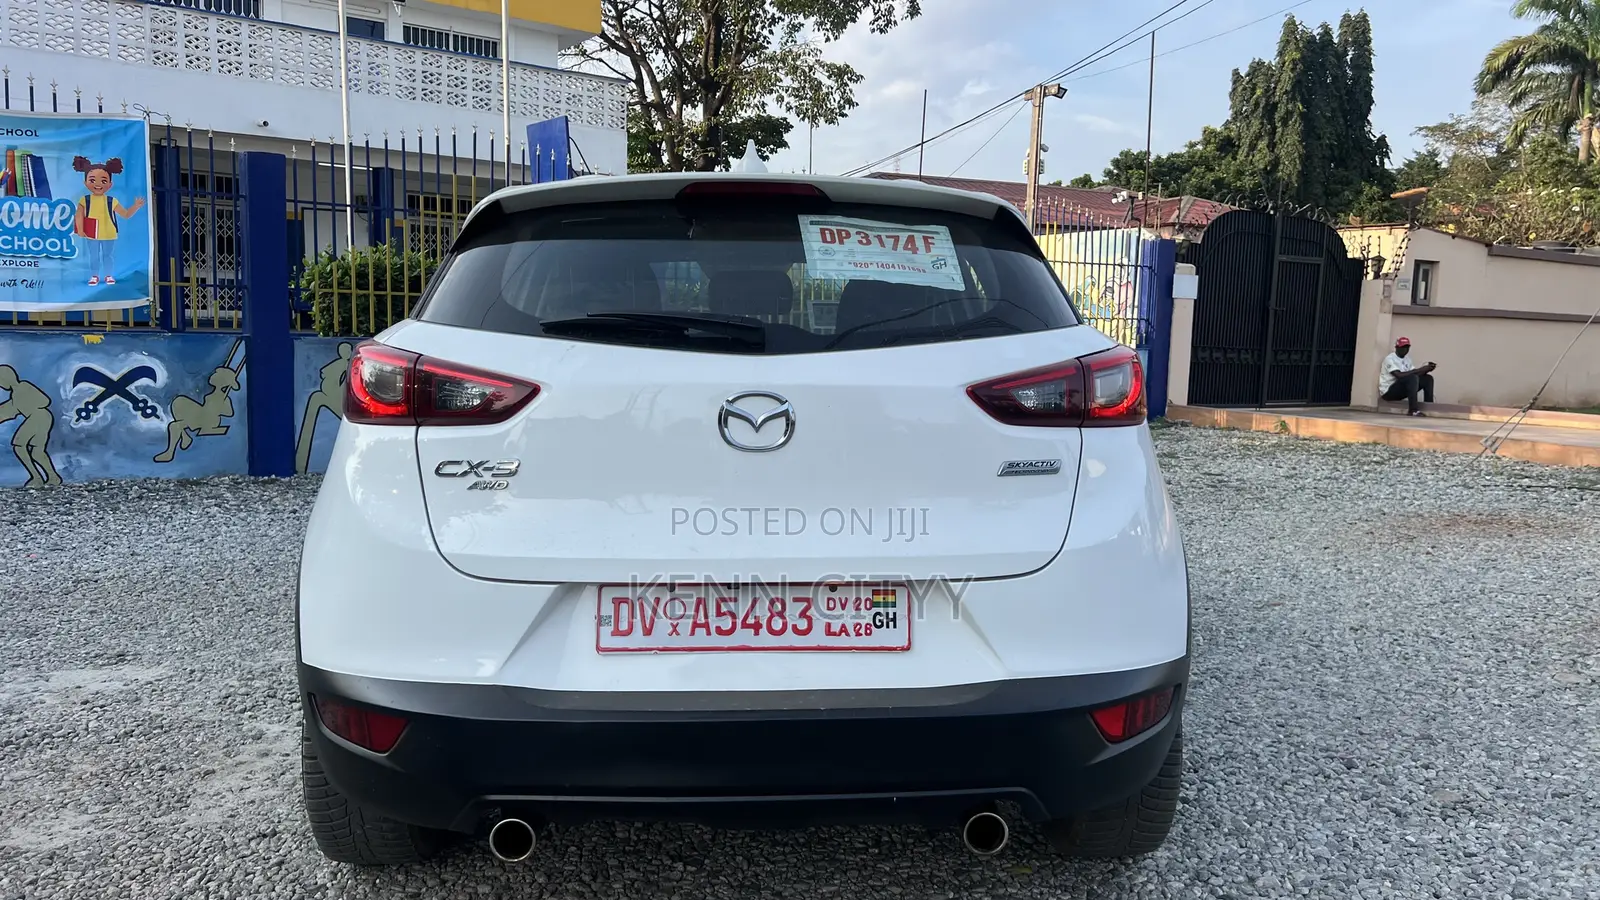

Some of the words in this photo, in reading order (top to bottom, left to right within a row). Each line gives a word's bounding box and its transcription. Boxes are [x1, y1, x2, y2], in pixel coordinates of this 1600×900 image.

[0, 128, 39, 137] CHOOL
[0, 200, 75, 232] ome
[0, 235, 71, 253] CHOOL
[819, 227, 851, 245] DP
[855, 231, 920, 254] 3174
[922, 235, 936, 254] F
[931, 261, 948, 270] GH
[434, 459, 520, 478] CX-3
[1006, 461, 1057, 469] SKYACTIV
[467, 480, 509, 491] AWD
[826, 596, 848, 611] DV
[852, 596, 873, 611] 20
[610, 597, 660, 637] DV
[689, 597, 814, 637] A5483
[872, 611, 897, 629] GH
[667, 622, 681, 637] X
[824, 621, 850, 637] LA
